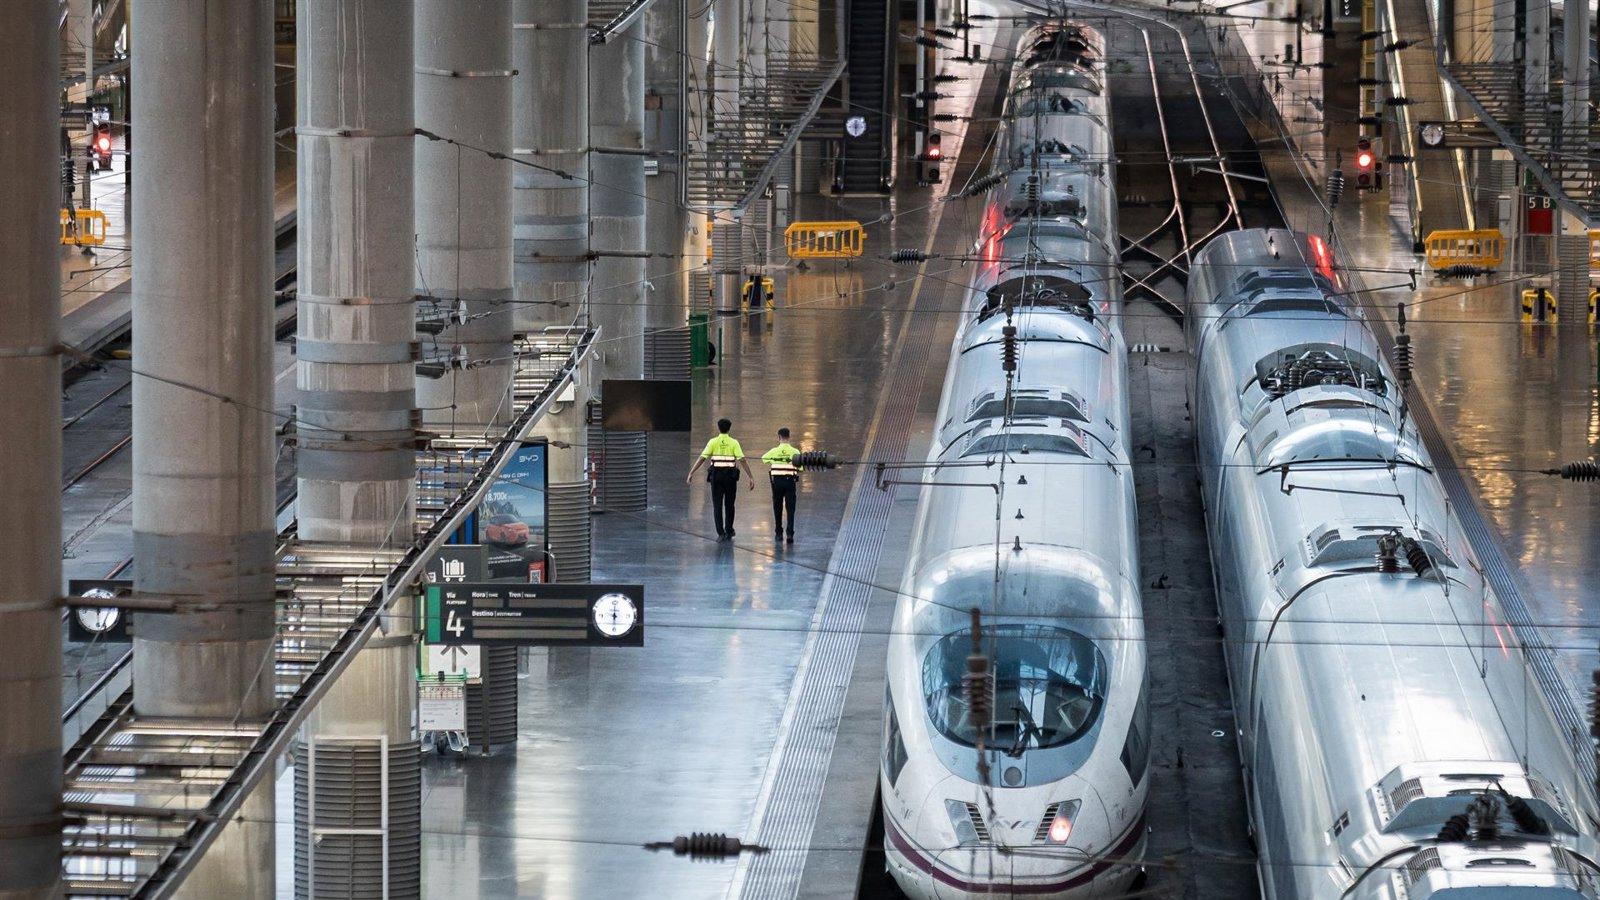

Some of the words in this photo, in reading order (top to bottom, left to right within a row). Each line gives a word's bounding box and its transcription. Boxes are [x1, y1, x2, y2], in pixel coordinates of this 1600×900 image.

[764, 186, 773, 198] 4
[1529, 196, 1536, 209] 5
[1543, 196, 1550, 209] B
[519, 454, 539, 462] BYD
[446, 610, 465, 637] 4
